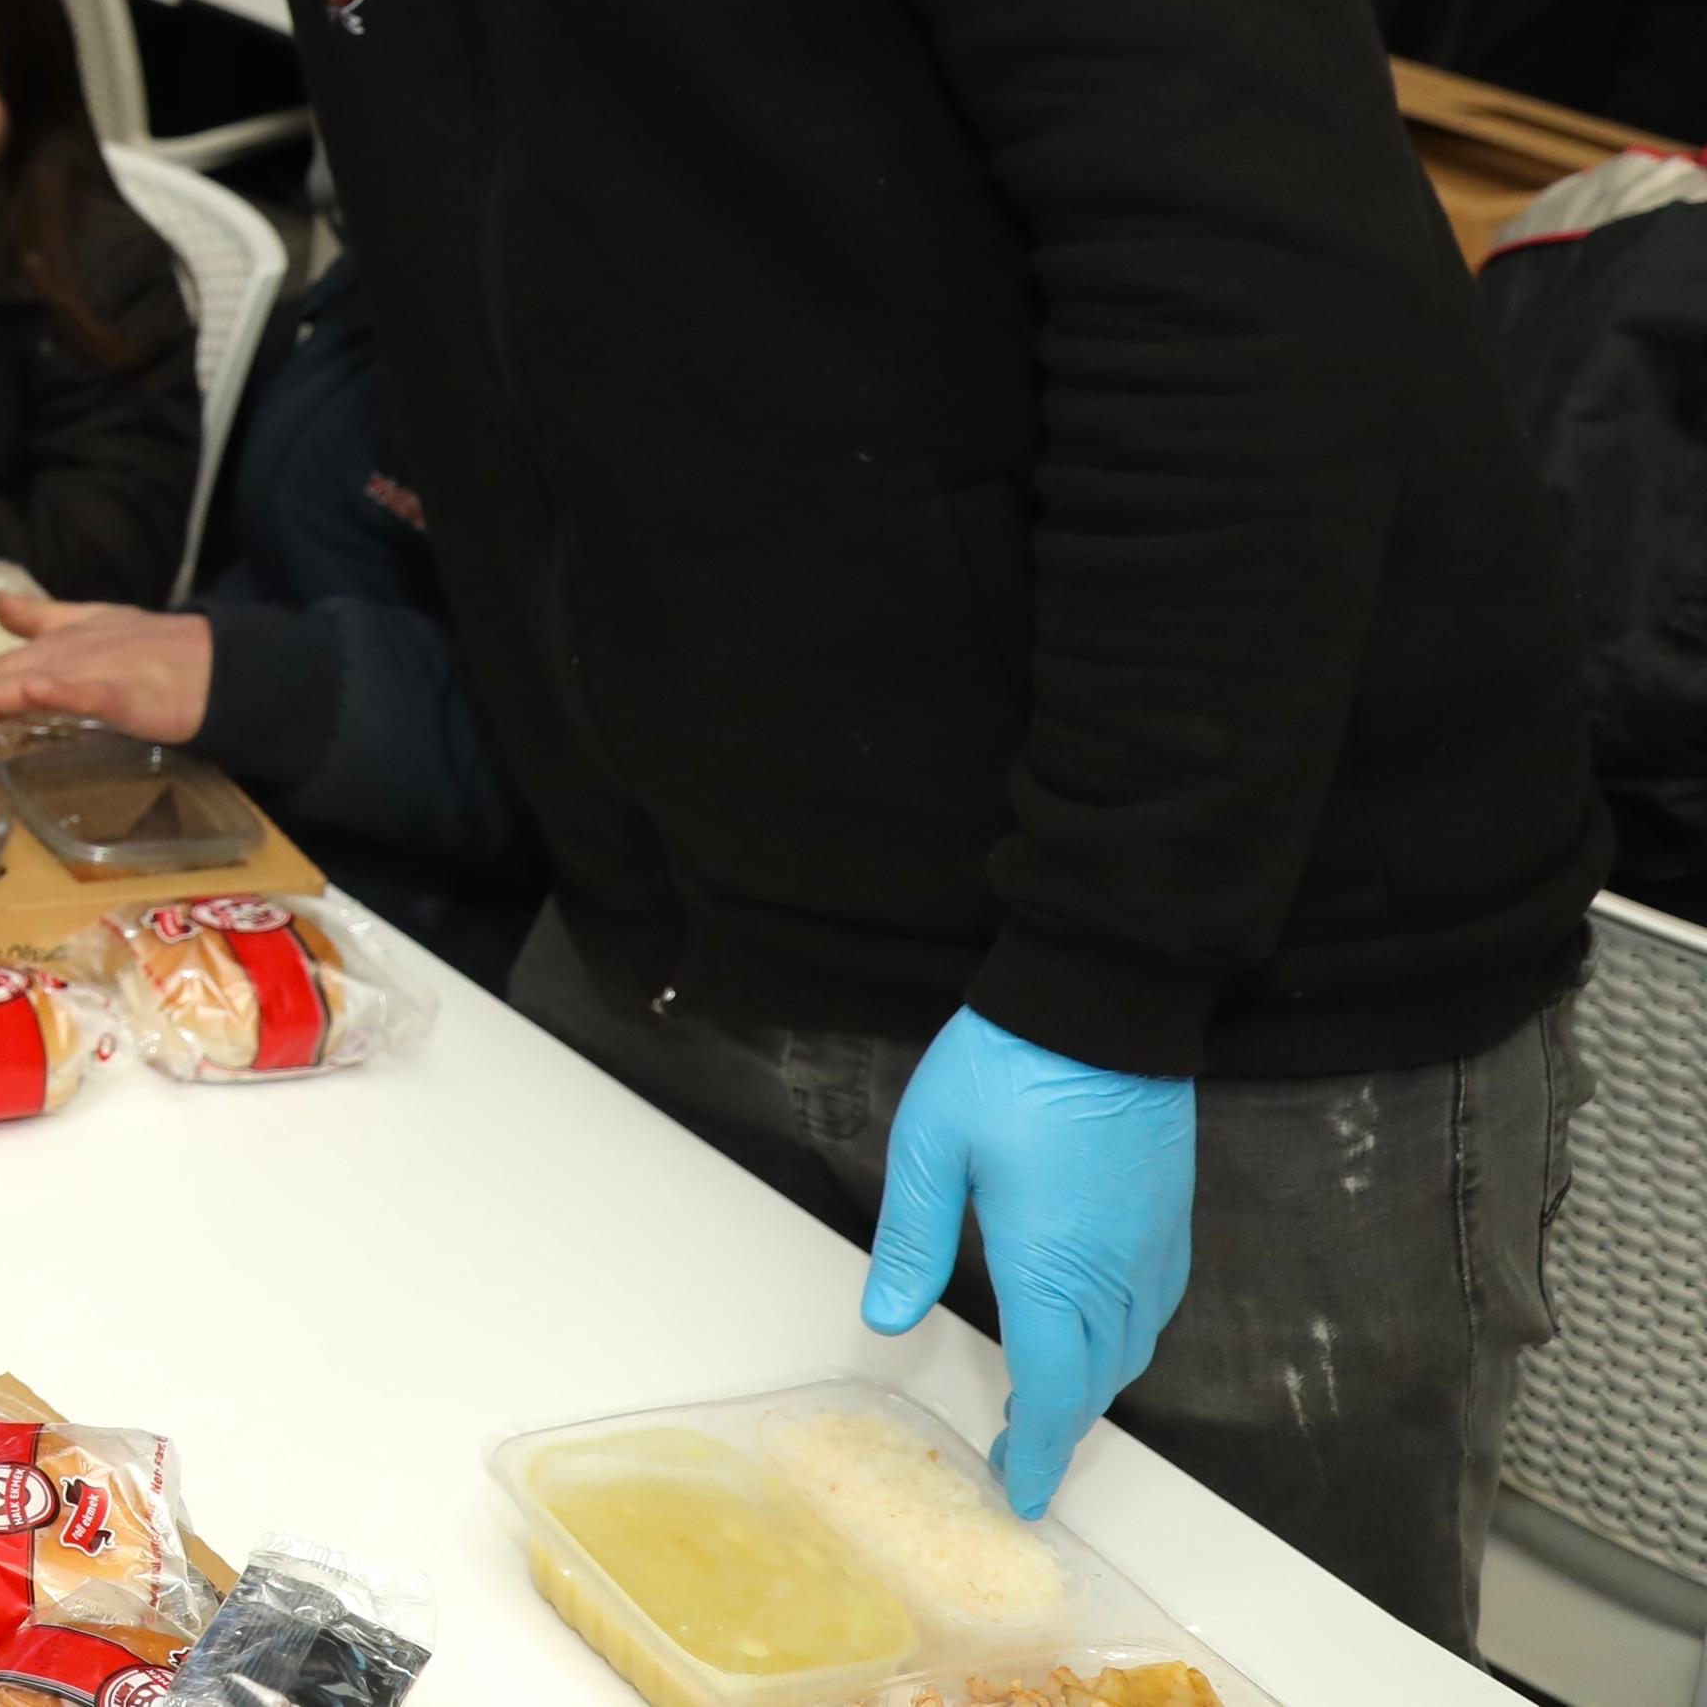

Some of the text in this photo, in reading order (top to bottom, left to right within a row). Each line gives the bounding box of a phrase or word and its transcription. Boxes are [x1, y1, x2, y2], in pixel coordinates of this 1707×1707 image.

[12, 1468, 27, 1526] HALK EKMEK
[82, 1493, 101, 1528] ekmek
